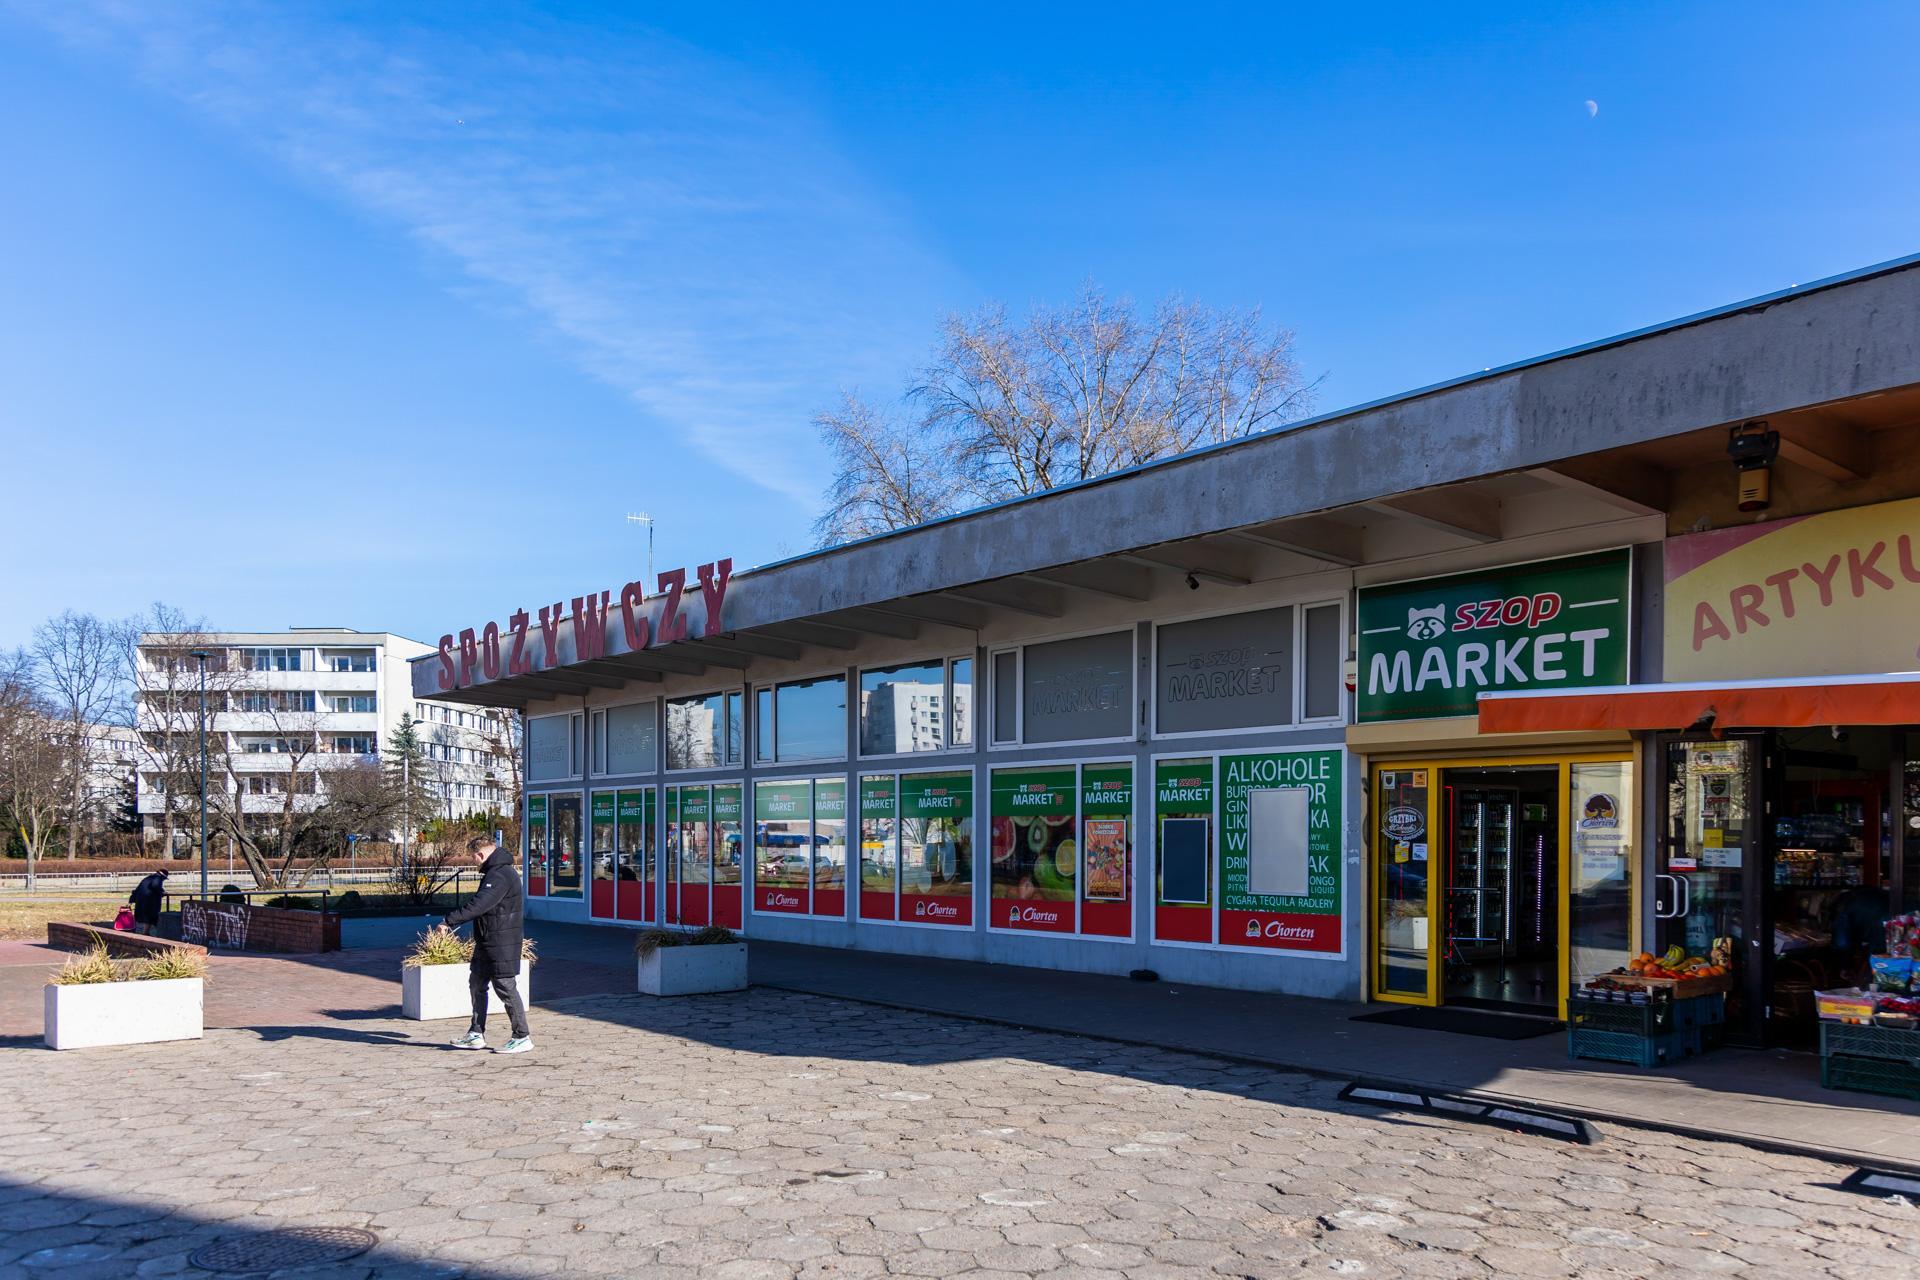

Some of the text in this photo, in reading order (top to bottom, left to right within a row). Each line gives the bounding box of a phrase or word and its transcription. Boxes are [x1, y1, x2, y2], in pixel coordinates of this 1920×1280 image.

[438, 557, 733, 690] SPOŻYWCZY
[1367, 628, 1610, 696] MARKET
[1227, 757, 1330, 782] ALKOHOLE
[1012, 793, 1053, 806] MARKET
[1085, 791, 1131, 804] MARKET
[1159, 788, 1210, 802] MARKET
[715, 804, 740, 813] MARKET
[768, 801, 796, 812] MARKET
[816, 800, 845, 810] MARKET
[862, 799, 895, 809] MARKET
[918, 797, 953, 808] MARKET
[683, 805, 707, 815] MARKET
[1226, 895, 1334, 908] CYGARA TEQUILA RADLERY
[927, 902, 957, 916] Chorten
[1022, 907, 1058, 923] Chorten
[1265, 920, 1315, 939] Chorten
